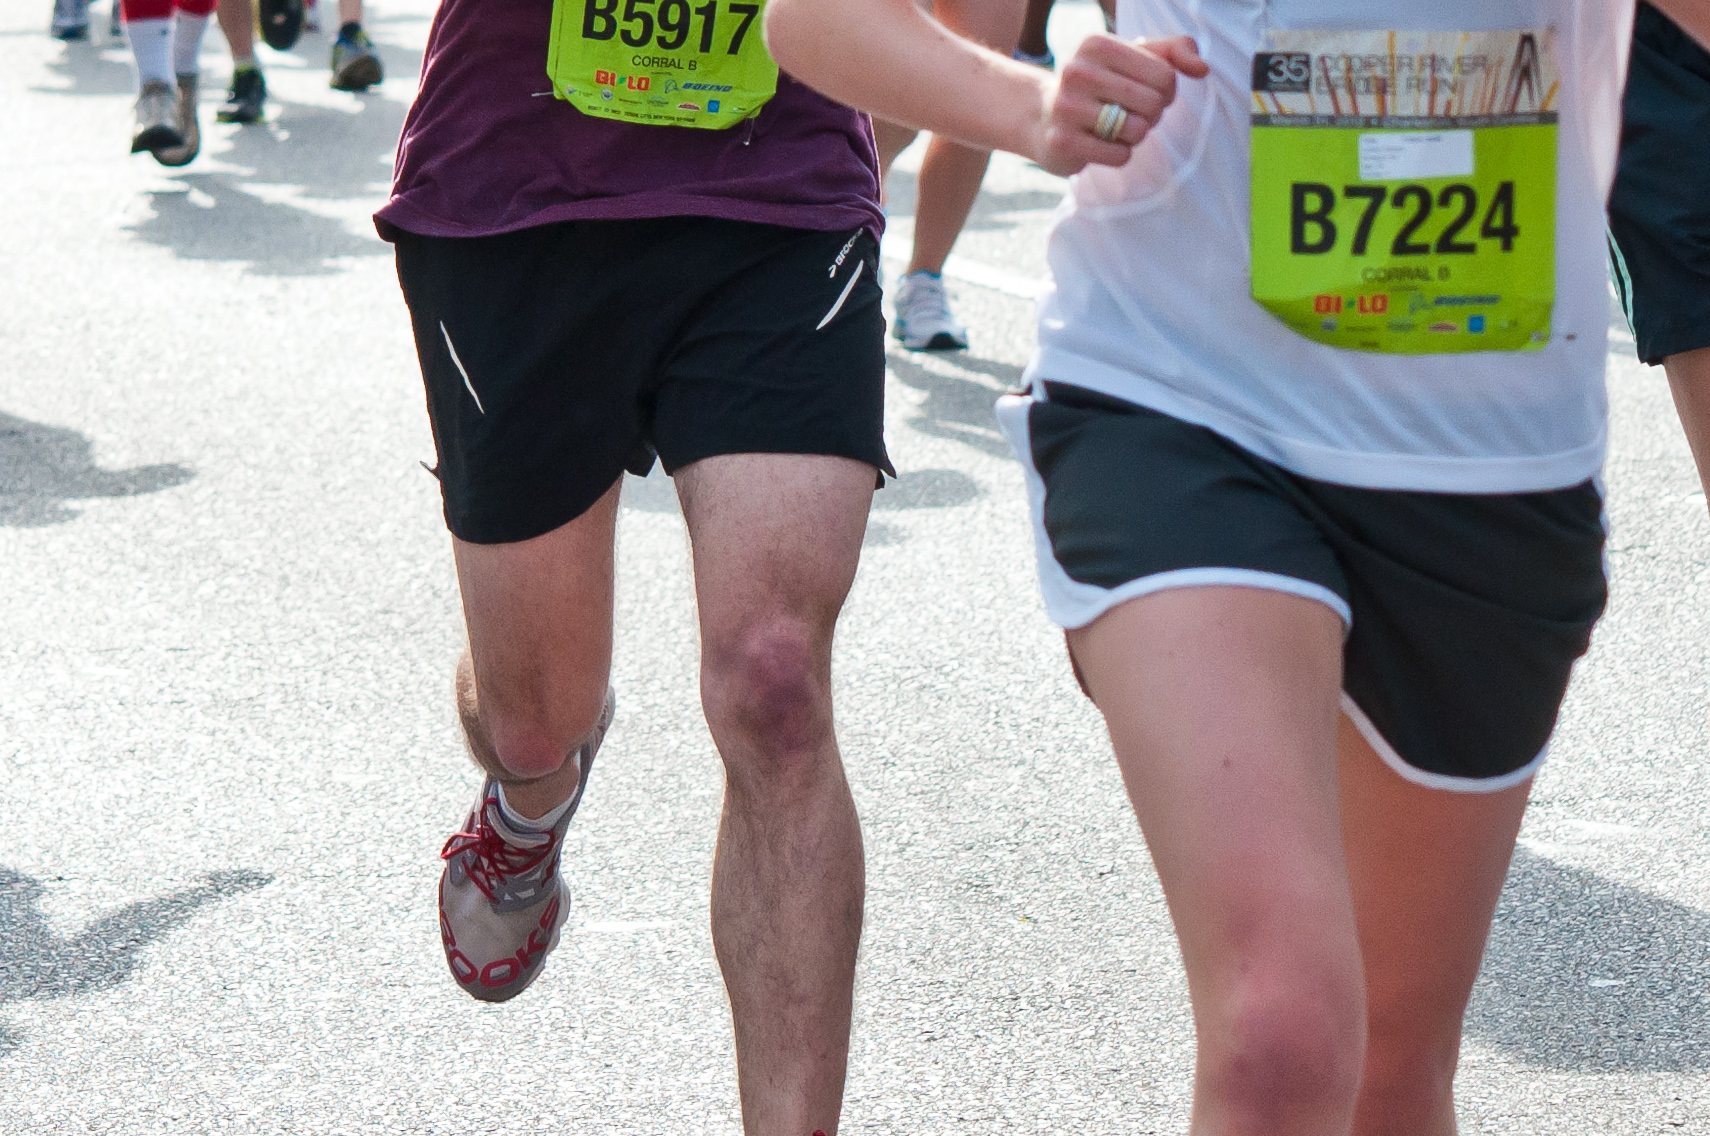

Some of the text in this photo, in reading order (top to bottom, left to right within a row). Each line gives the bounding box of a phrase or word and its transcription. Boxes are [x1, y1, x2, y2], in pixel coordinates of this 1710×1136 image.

[632, 55, 698, 71] CORRAL B
[1267, 54, 1309, 83] 35
[1290, 181, 1520, 256] B7224
